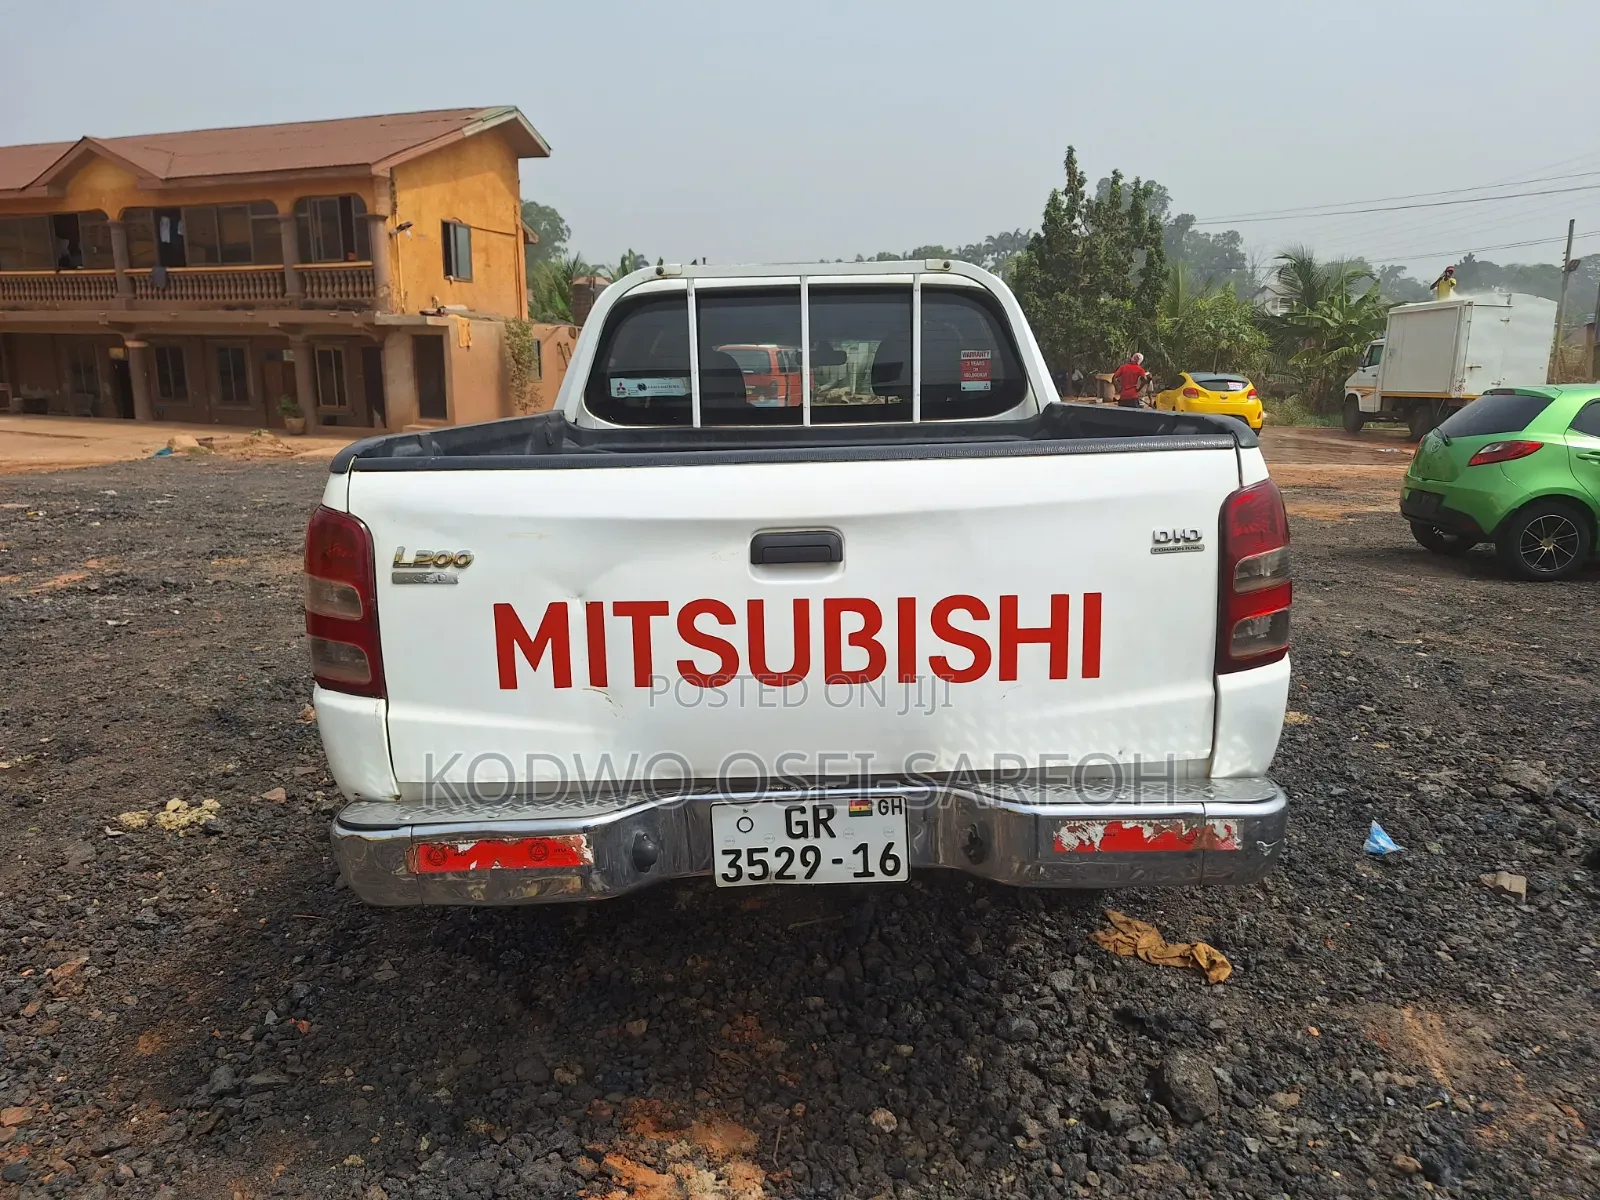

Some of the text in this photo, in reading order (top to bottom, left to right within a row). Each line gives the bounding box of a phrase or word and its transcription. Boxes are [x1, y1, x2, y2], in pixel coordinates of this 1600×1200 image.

[392, 546, 475, 569] L200
[493, 592, 1102, 690] MITSUBISHI
[785, 804, 837, 839] GR
[877, 799, 903, 816] GH
